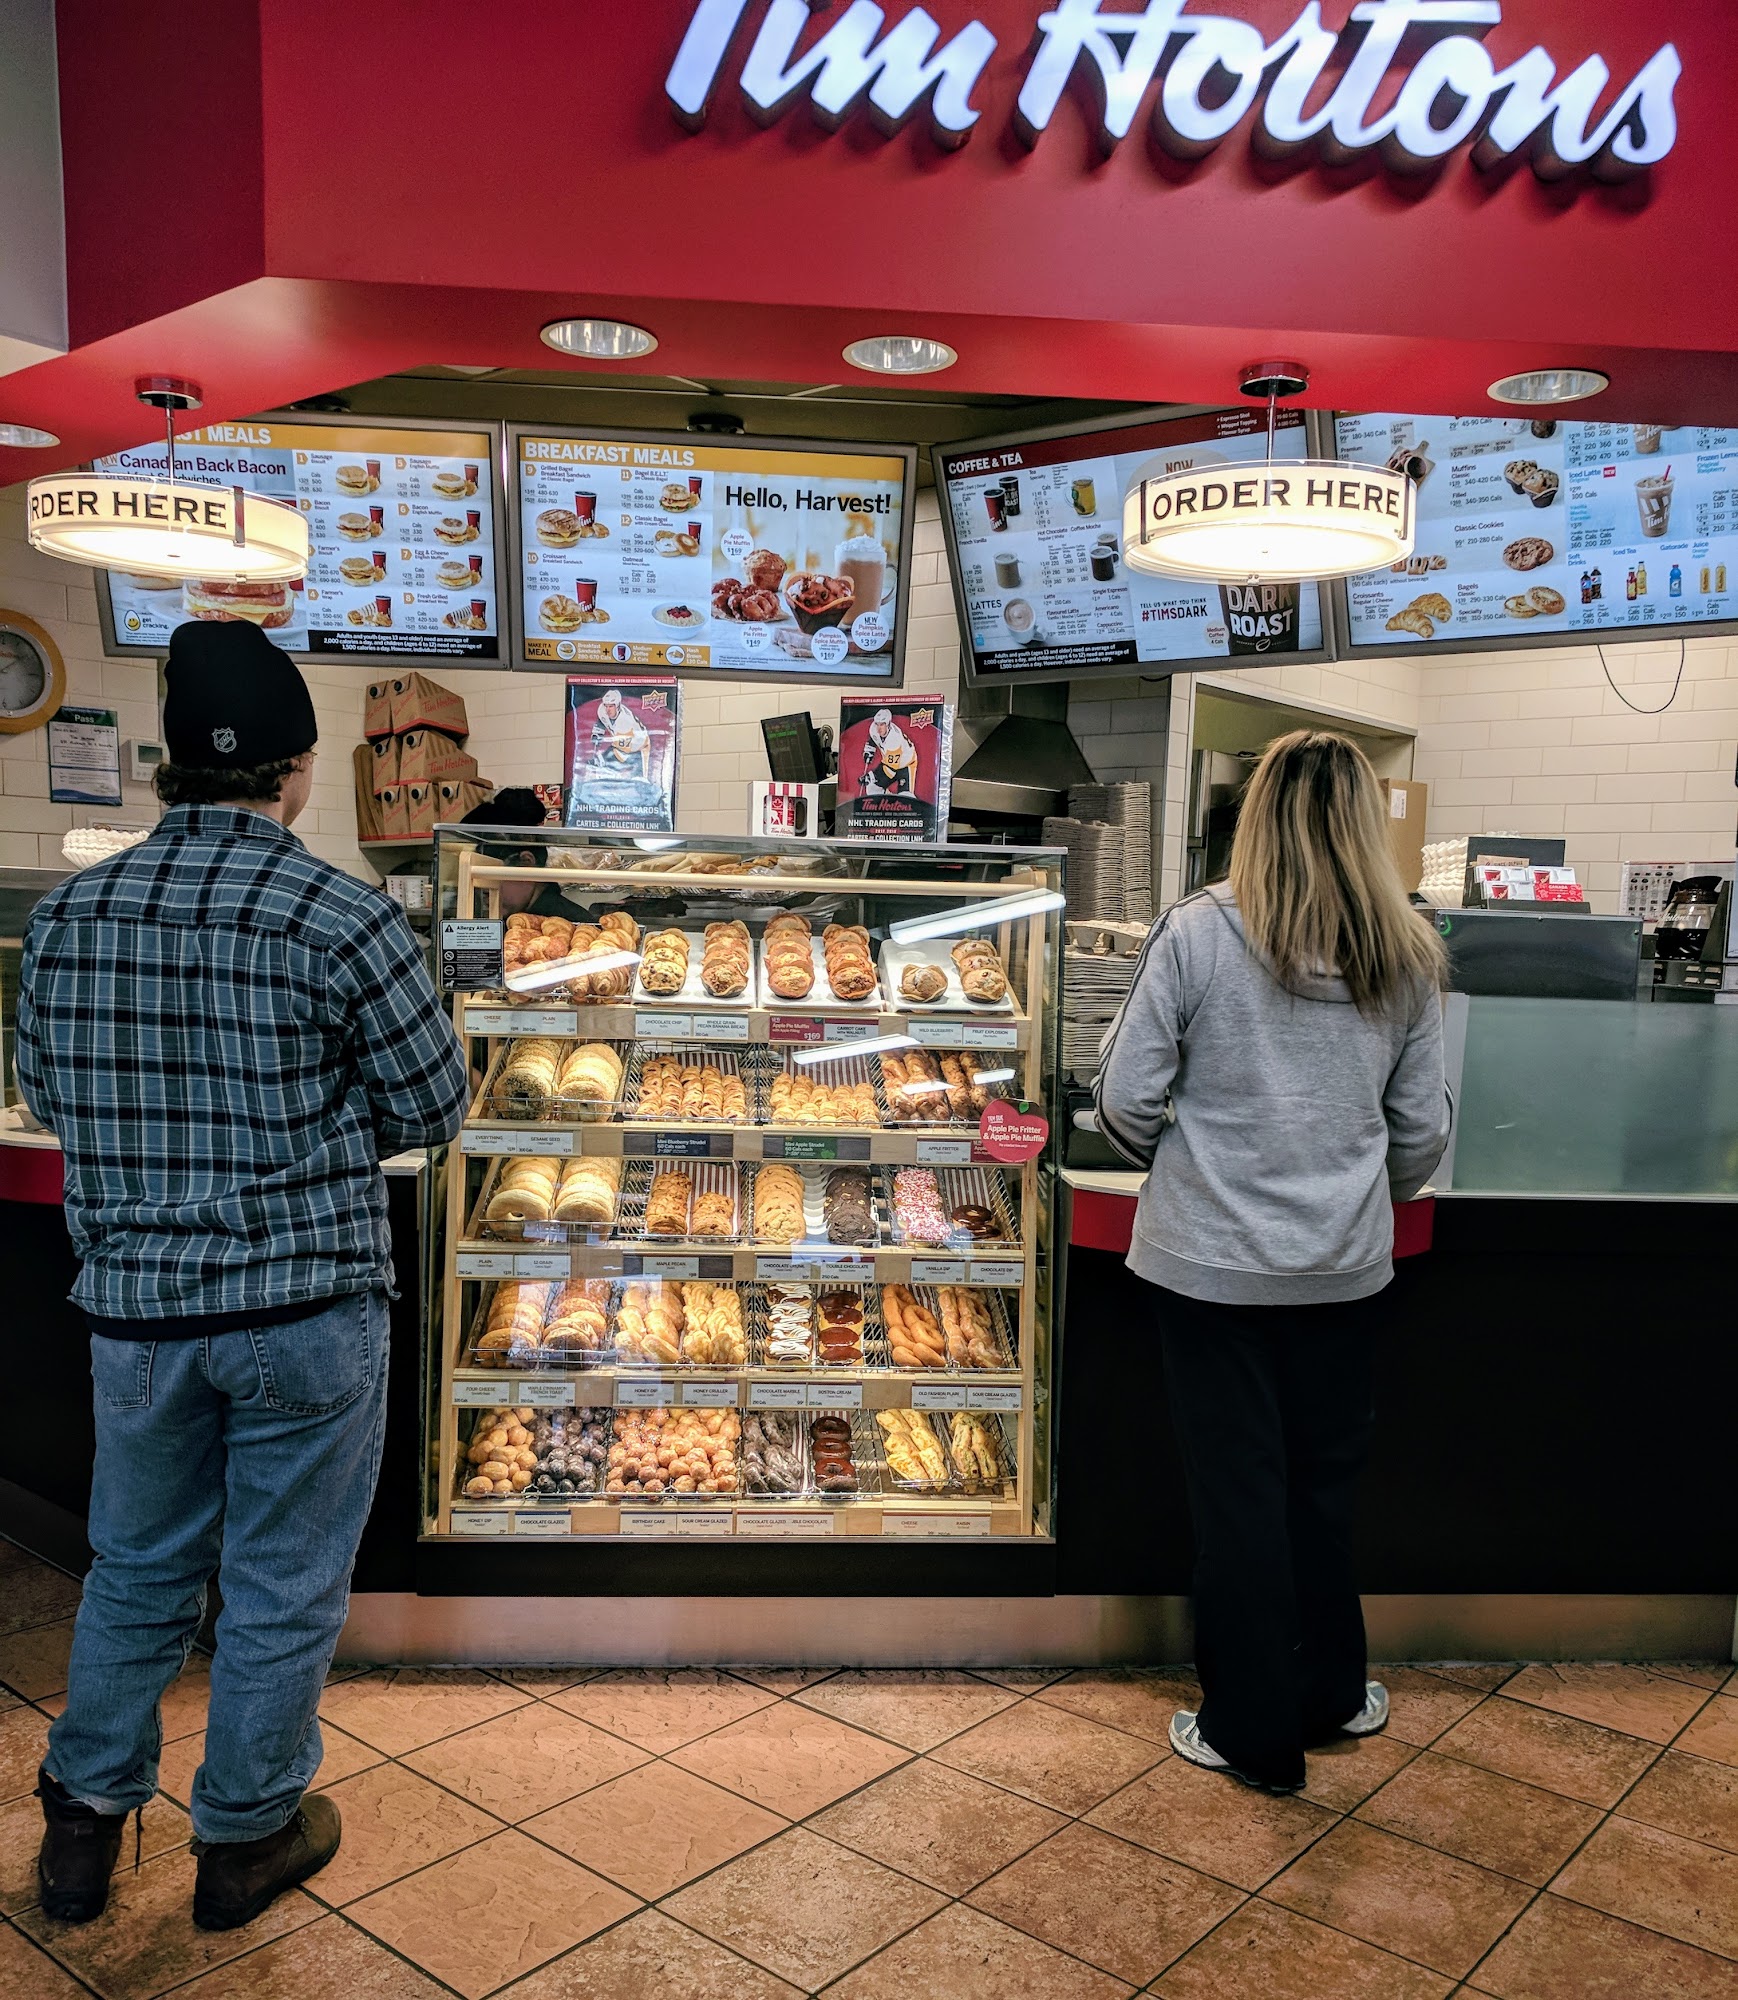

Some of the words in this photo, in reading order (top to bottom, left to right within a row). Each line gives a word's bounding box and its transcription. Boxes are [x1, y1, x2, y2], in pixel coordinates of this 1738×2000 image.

[664, 0, 997, 132] Tim
[1018, 0, 1682, 165] Hortons
[1339, 420, 1361, 428] Donuts
[207, 427, 272, 445] MEALS
[1584, 431, 1596, 439] 150
[1599, 429, 1611, 438] 250
[1616, 426, 1629, 434] 290
[1584, 443, 1597, 451] 220
[1599, 441, 1612, 449] 360
[1616, 438, 1628, 446] 410
[1713, 437, 1727, 446] 260
[525, 442, 630, 464] BREAKFAST
[633, 448, 695, 467] MEALS
[1584, 455, 1597, 463] 290
[1599, 453, 1612, 461] 470
[1697, 454, 1719, 463] Frozen
[120, 453, 192, 472] Canadan
[196, 457, 235, 473] Back
[238, 460, 286, 475] Bacon
[948, 458, 990, 475] COFFEE
[992, 458, 999, 468] &
[1000, 452, 1023, 468] TEA
[1165, 459, 1194, 474] NOW
[541, 465, 557, 474] Grilled
[559, 467, 574, 476] Bagel
[1451, 465, 1477, 474] Muffins
[1584, 468, 1602, 478] Latte
[726, 485, 787, 512] Hello,
[796, 489, 890, 514] Harvest!
[1152, 478, 1291, 520] ORDER
[1306, 478, 1400, 519] HERE
[1490, 495, 1503, 503] Cals
[112, 491, 227, 529] HERE
[653, 517, 668, 525] Bagel
[1713, 513, 1725, 521] 160
[1454, 524, 1477, 532] Classic
[1478, 521, 1505, 530] Cookies
[1713, 525, 1725, 533] 210
[1660, 542, 1689, 551] Gatorade
[1692, 541, 1709, 549] Juice
[1612, 548, 1626, 556] Iced
[1627, 547, 1637, 555] Tea
[1568, 559, 1587, 567] Drinks
[1457, 583, 1479, 592] Bagels
[1226, 585, 1292, 613] DARK
[1352, 592, 1384, 600] Croissants
[970, 599, 1003, 612] LATTES
[1095, 605, 1120, 613] Americano
[1141, 604, 1208, 623] #TIMSDARK
[1675, 611, 1687, 619] 150
[864, 616, 878, 625] NEW
[1229, 609, 1294, 638] ROAST
[528, 648, 552, 657] MEAL
[74, 713, 95, 724] Pass
[618, 738, 632, 748] 87
[887, 753, 901, 764] 87
[429, 762, 443, 774] Tim
[443, 757, 474, 771] Hortons
[576, 804, 593, 812] NHL
[595, 804, 631, 814] TRADING
[632, 806, 660, 815] CARDS
[862, 798, 878, 811] Tim
[879, 799, 912, 812] Hortons
[576, 820, 600, 828] CARTES
[607, 821, 645, 830] COLLECTION
[864, 819, 897, 827] TRADING
[898, 820, 924, 828] CARDS
[456, 925, 475, 934] Allergy
[772, 1022, 784, 1030] Apple
[803, 1032, 821, 1041] $169
[987, 1125, 1007, 1134] Apple
[1007, 1125, 1019, 1133] Pie
[1019, 1126, 1042, 1134] Fritter
[667, 1139, 688, 1147] Blueberry
[990, 1133, 1011, 1142] Apple
[1022, 1135, 1045, 1143] Muffin
